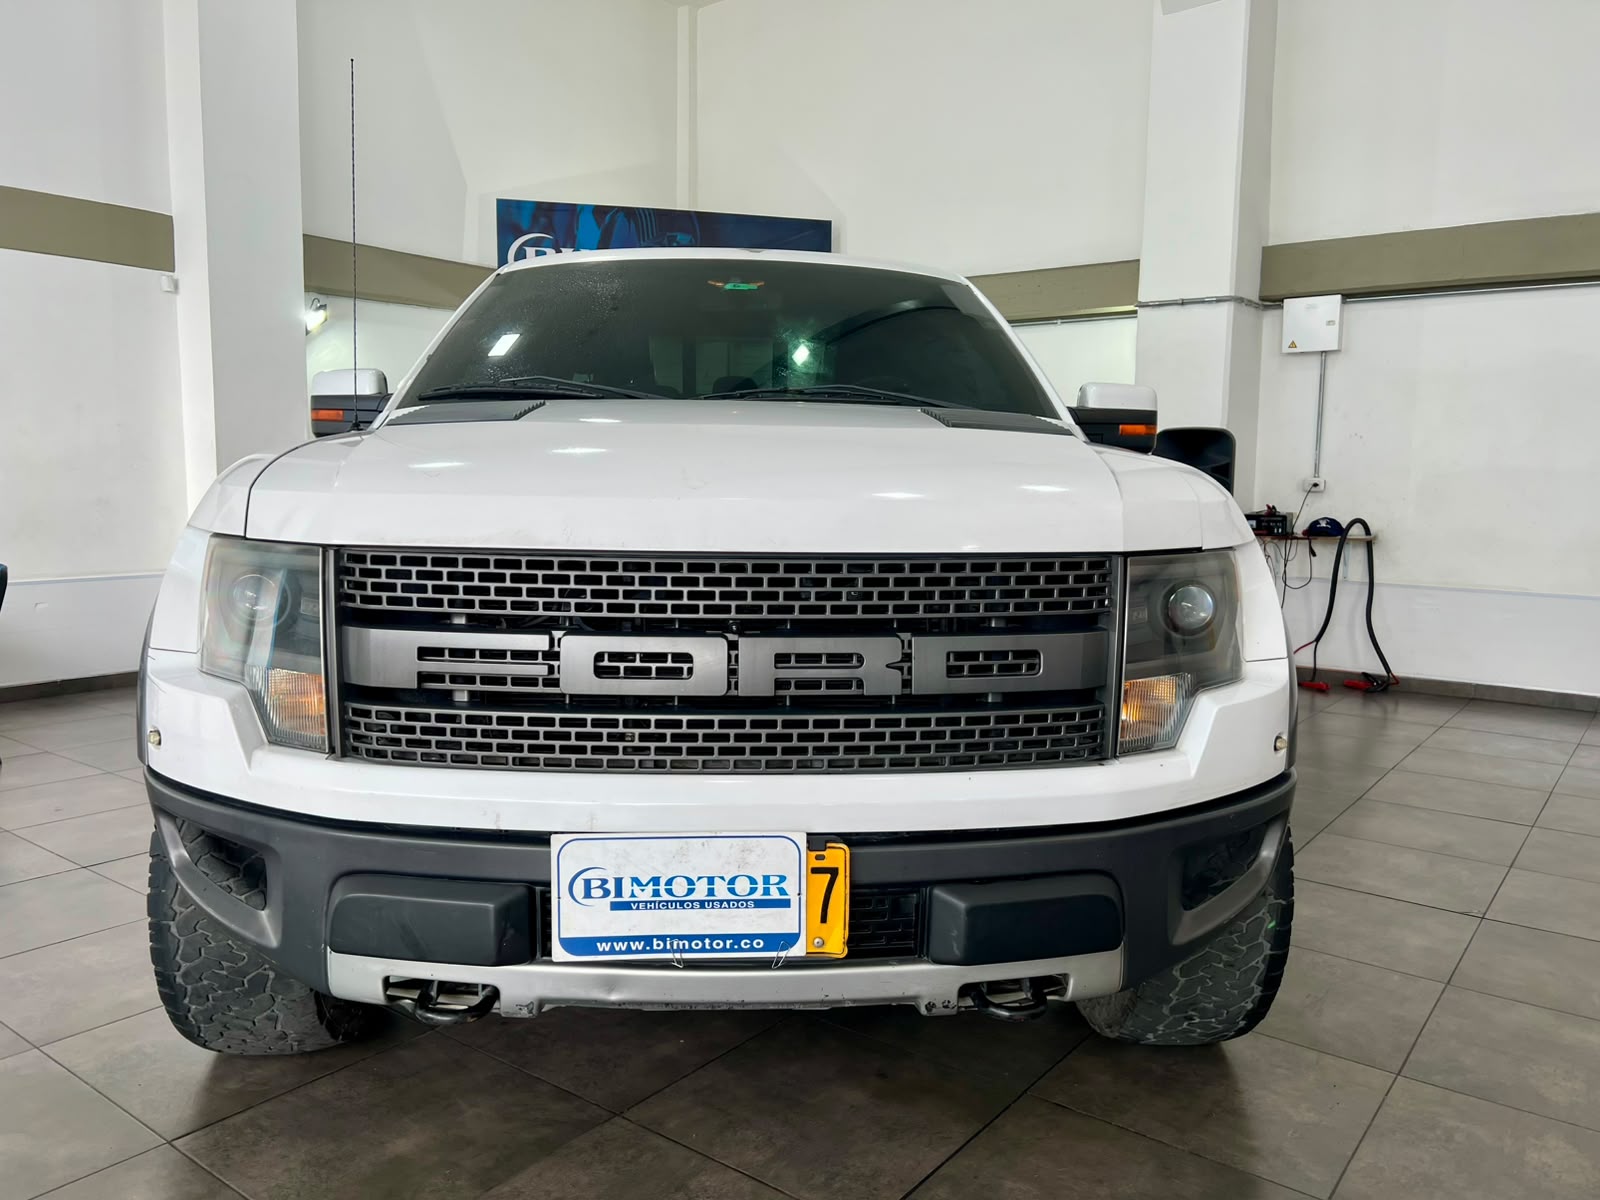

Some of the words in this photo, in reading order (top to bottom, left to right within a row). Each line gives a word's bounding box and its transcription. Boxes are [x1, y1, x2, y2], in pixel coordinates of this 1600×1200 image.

[342, 626, 1108, 698] FORD
[581, 874, 789, 900] BIMOTOR
[810, 867, 839, 924] 7
[631, 900, 701, 911] VEHÍCULOS
[704, 900, 755, 910] USADOS
[596, 937, 765, 952] www.bimotor.co
